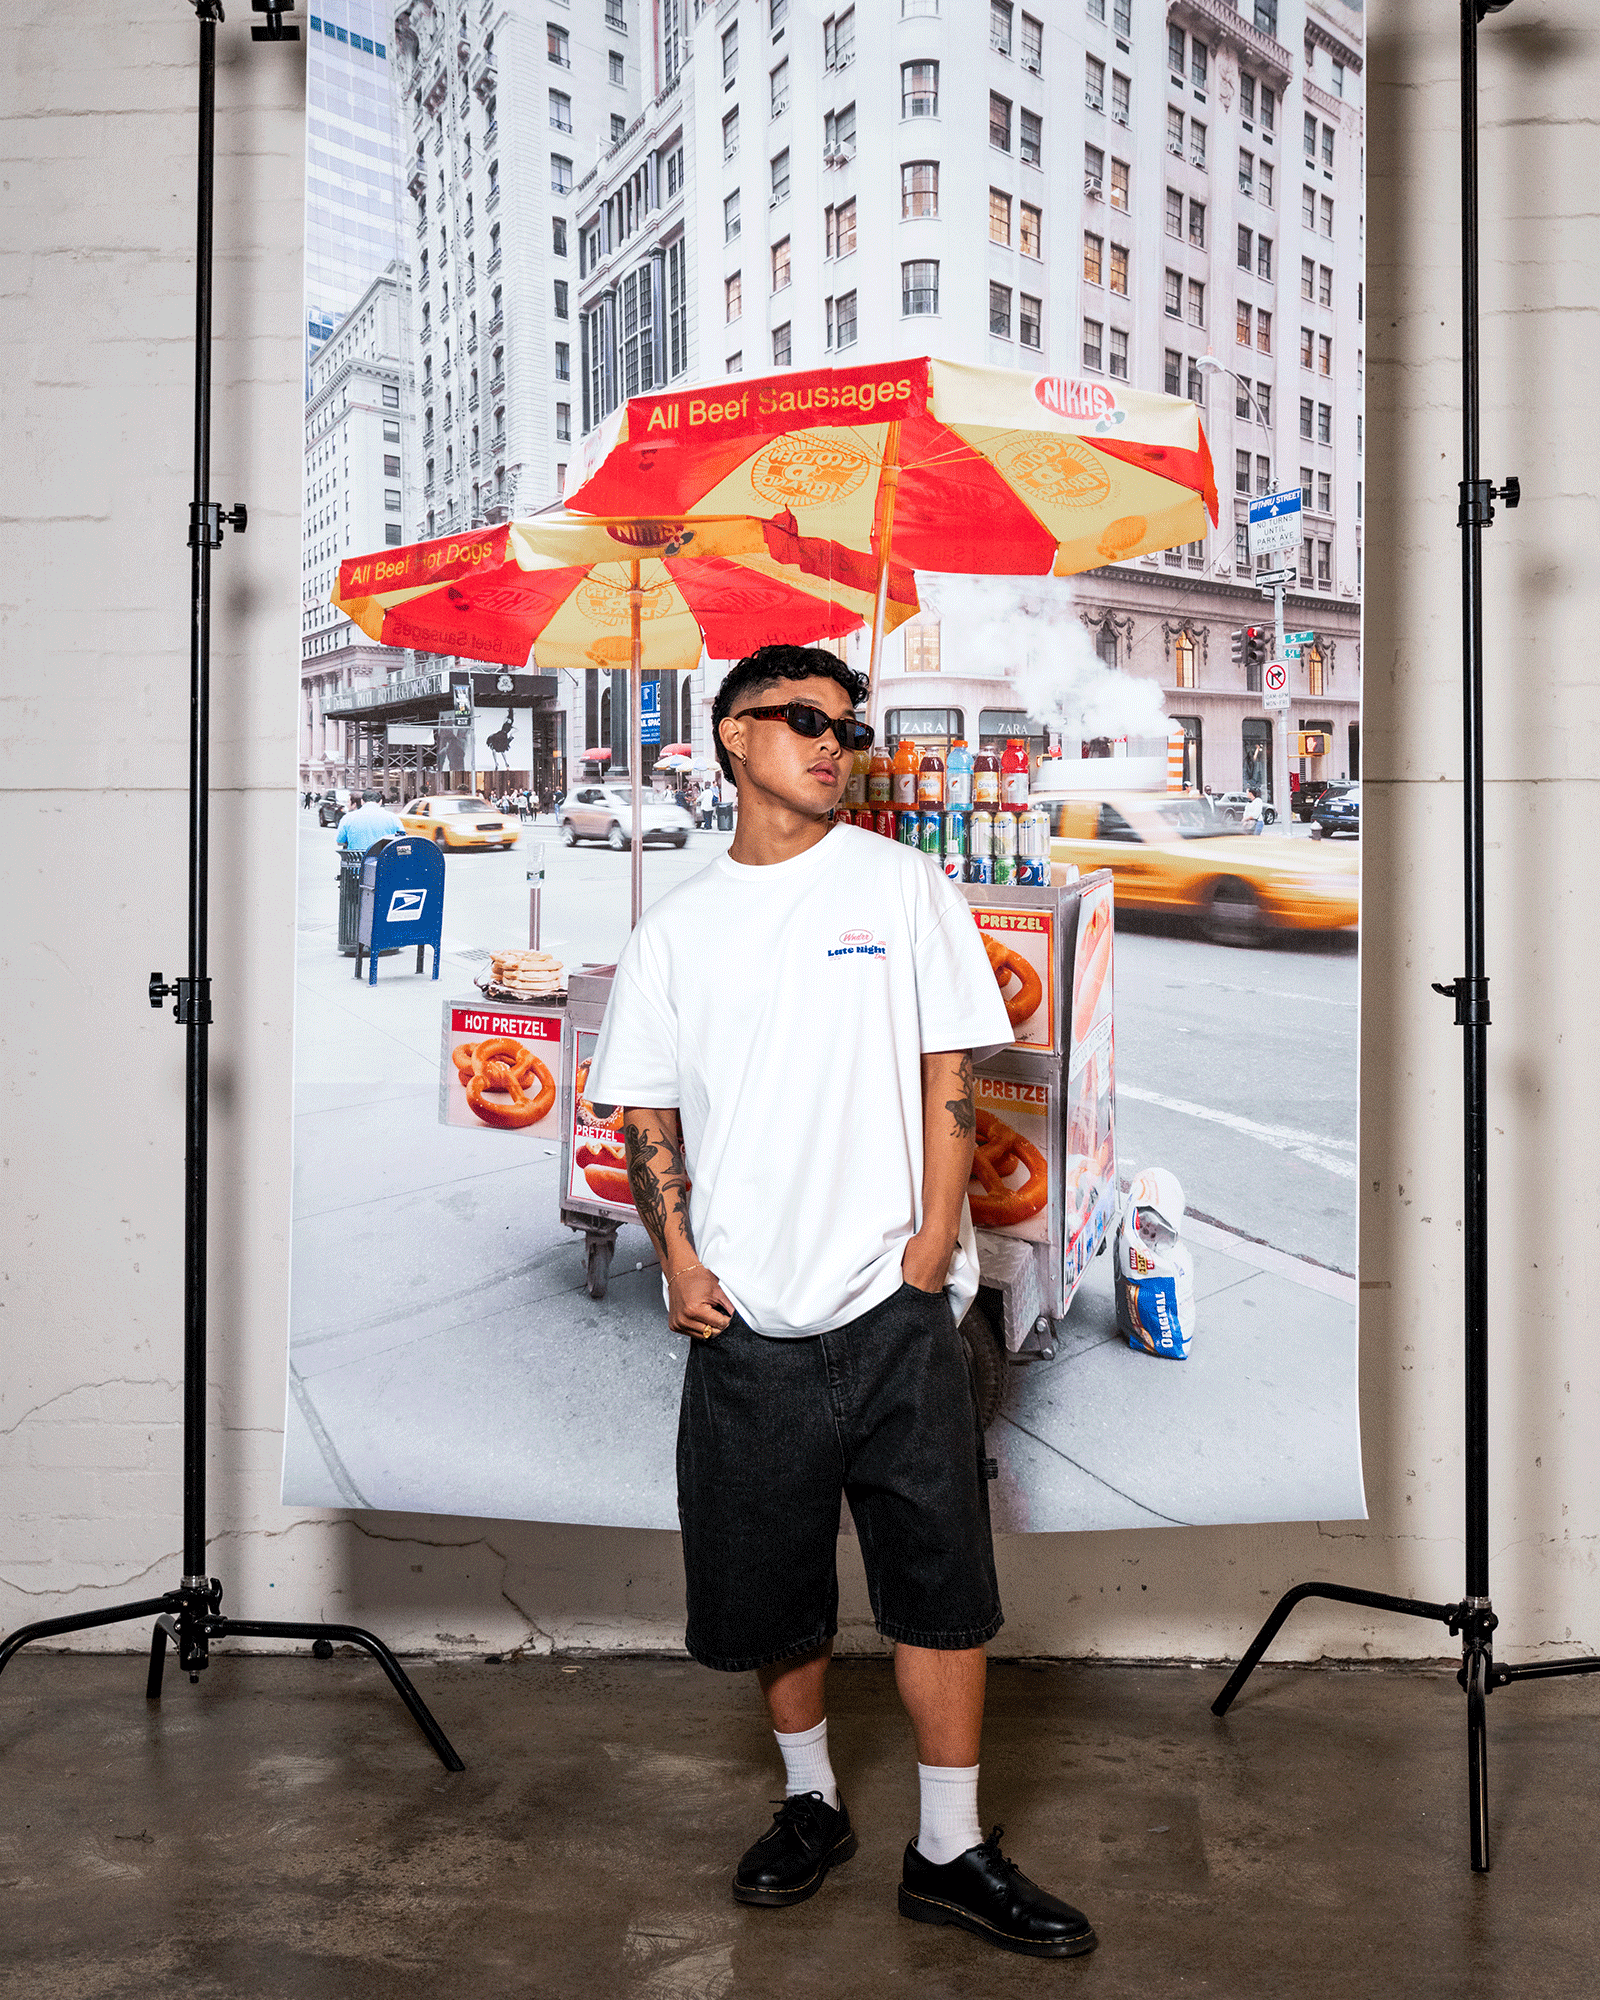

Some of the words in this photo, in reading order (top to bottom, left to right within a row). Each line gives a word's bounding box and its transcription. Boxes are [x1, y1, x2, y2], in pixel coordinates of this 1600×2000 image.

[1044, 378, 1107, 416] NIKAS
[647, 404, 679, 432] All
[689, 391, 749, 426] Beef
[1275, 490, 1300, 505] STREET
[1256, 520, 1266, 530] NO
[1269, 514, 1294, 526] TURNS
[1263, 525, 1286, 536] UNTIL
[1257, 536, 1277, 548] PARK
[1279, 531, 1294, 541] AVE
[350, 565, 371, 585] All
[375, 554, 411, 581] Beef
[446, 541, 493, 565] Dogs
[900, 722, 945, 734] ZARA
[998, 722, 1029, 735] ZARA
[980, 914, 1044, 931] PRETZEL
[827, 947, 854, 957] Late
[856, 945, 886, 955] Night
[464, 1014, 490, 1031] HOT
[492, 1017, 548, 1037] PRETZEL
[576, 1124, 618, 1142] PRETZEL
[1155, 1291, 1174, 1348] ORIGINAL
